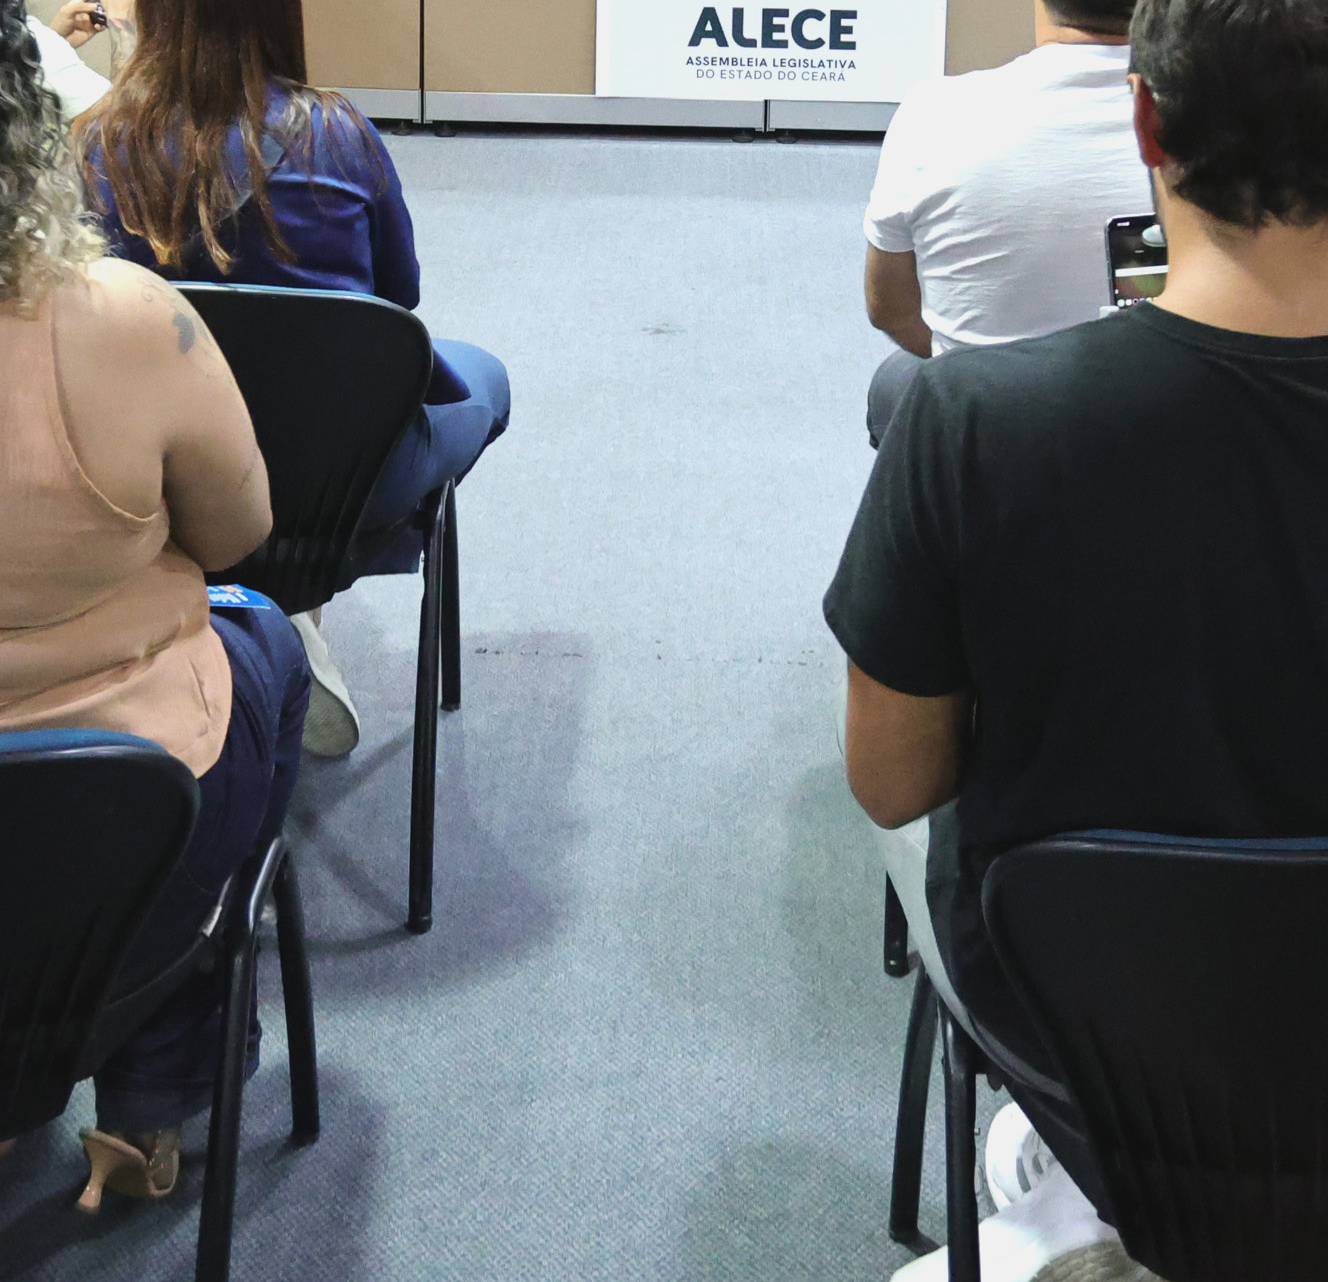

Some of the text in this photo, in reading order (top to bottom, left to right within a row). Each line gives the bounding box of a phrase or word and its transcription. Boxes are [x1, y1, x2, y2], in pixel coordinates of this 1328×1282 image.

[687, 6, 858, 51] ALECE
[685, 55, 857, 70] ASSEMBLEIA LEGISLATIVA
[696, 68, 846, 82] DO ESTADO DO CEARÁ
